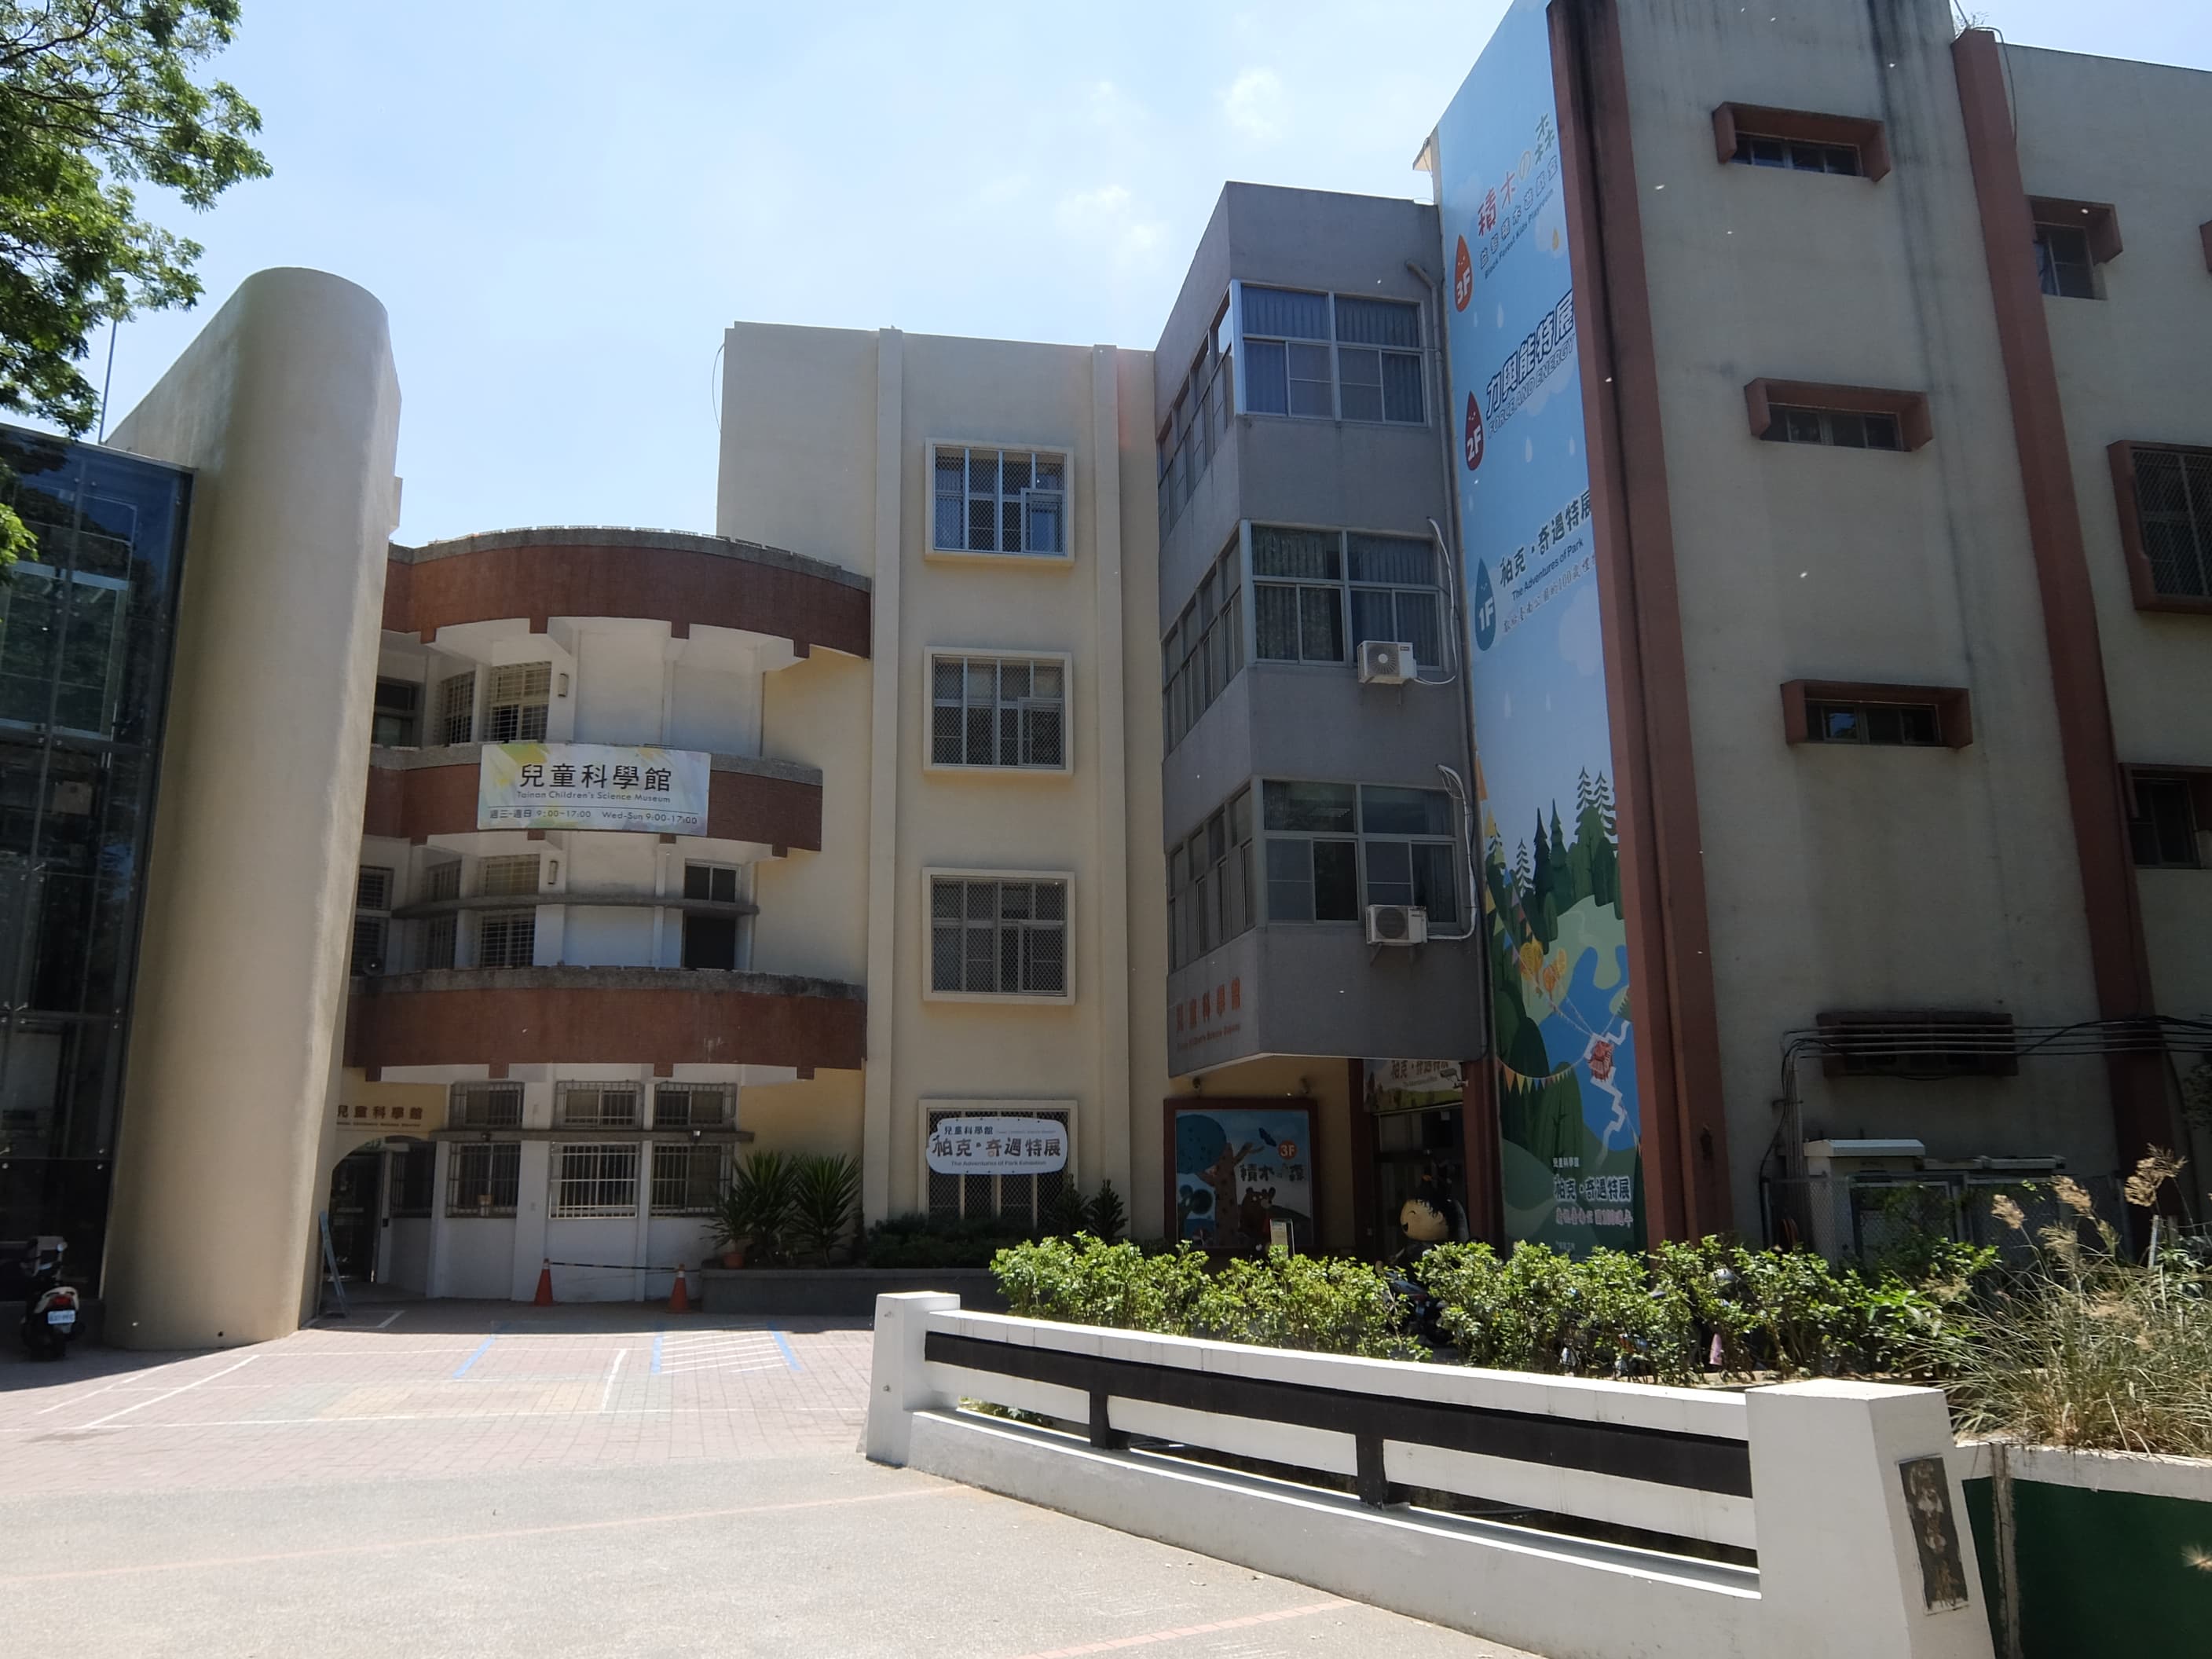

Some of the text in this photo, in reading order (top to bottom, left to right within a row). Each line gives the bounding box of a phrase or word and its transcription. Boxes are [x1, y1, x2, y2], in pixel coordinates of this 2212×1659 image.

[1456, 266, 1471, 305] 3F
[1489, 333, 1577, 439] FORCE AND ENERGY
[1467, 424, 1482, 462] 2F
[1511, 588, 1523, 602] The
[1524, 557, 1558, 591] Adventures
[1568, 537, 1584, 561] Park
[1478, 596, 1494, 632] 1F
[519, 763, 672, 792] 兒童科學館
[548, 791, 595, 800] Children's
[597, 792, 632, 800] Science
[634, 793, 671, 804] Museum
[602, 811, 644, 821] Wed-Sun
[337, 1104, 423, 1120] 兒童科學館
[944, 1126, 994, 1136] 兒童科學館
[1280, 1144, 1296, 1157] 3F
